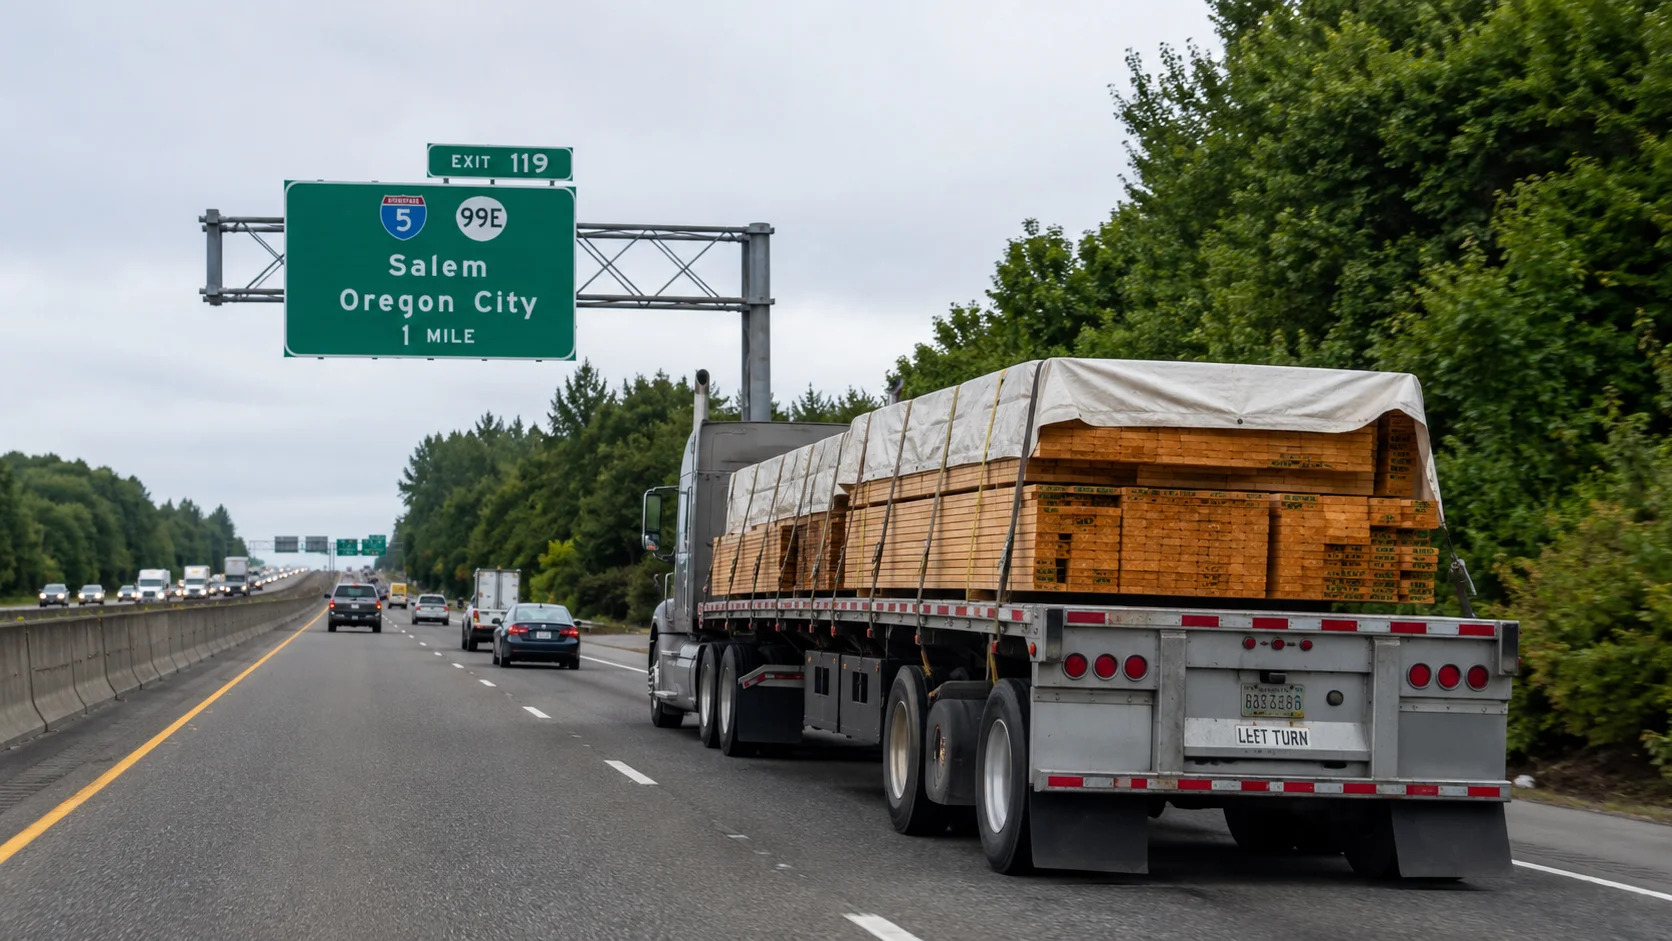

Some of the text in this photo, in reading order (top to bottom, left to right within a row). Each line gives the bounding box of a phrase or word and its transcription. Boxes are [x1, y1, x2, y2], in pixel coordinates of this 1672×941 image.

[452, 153, 549, 173] EXIT 119
[396, 208, 412, 232] 5
[460, 207, 503, 229] 99E
[388, 254, 487, 278] Salem
[340, 288, 538, 319] Oregon City
[402, 325, 475, 345] 1 MILE
[1272, 729, 1309, 746] TURN
